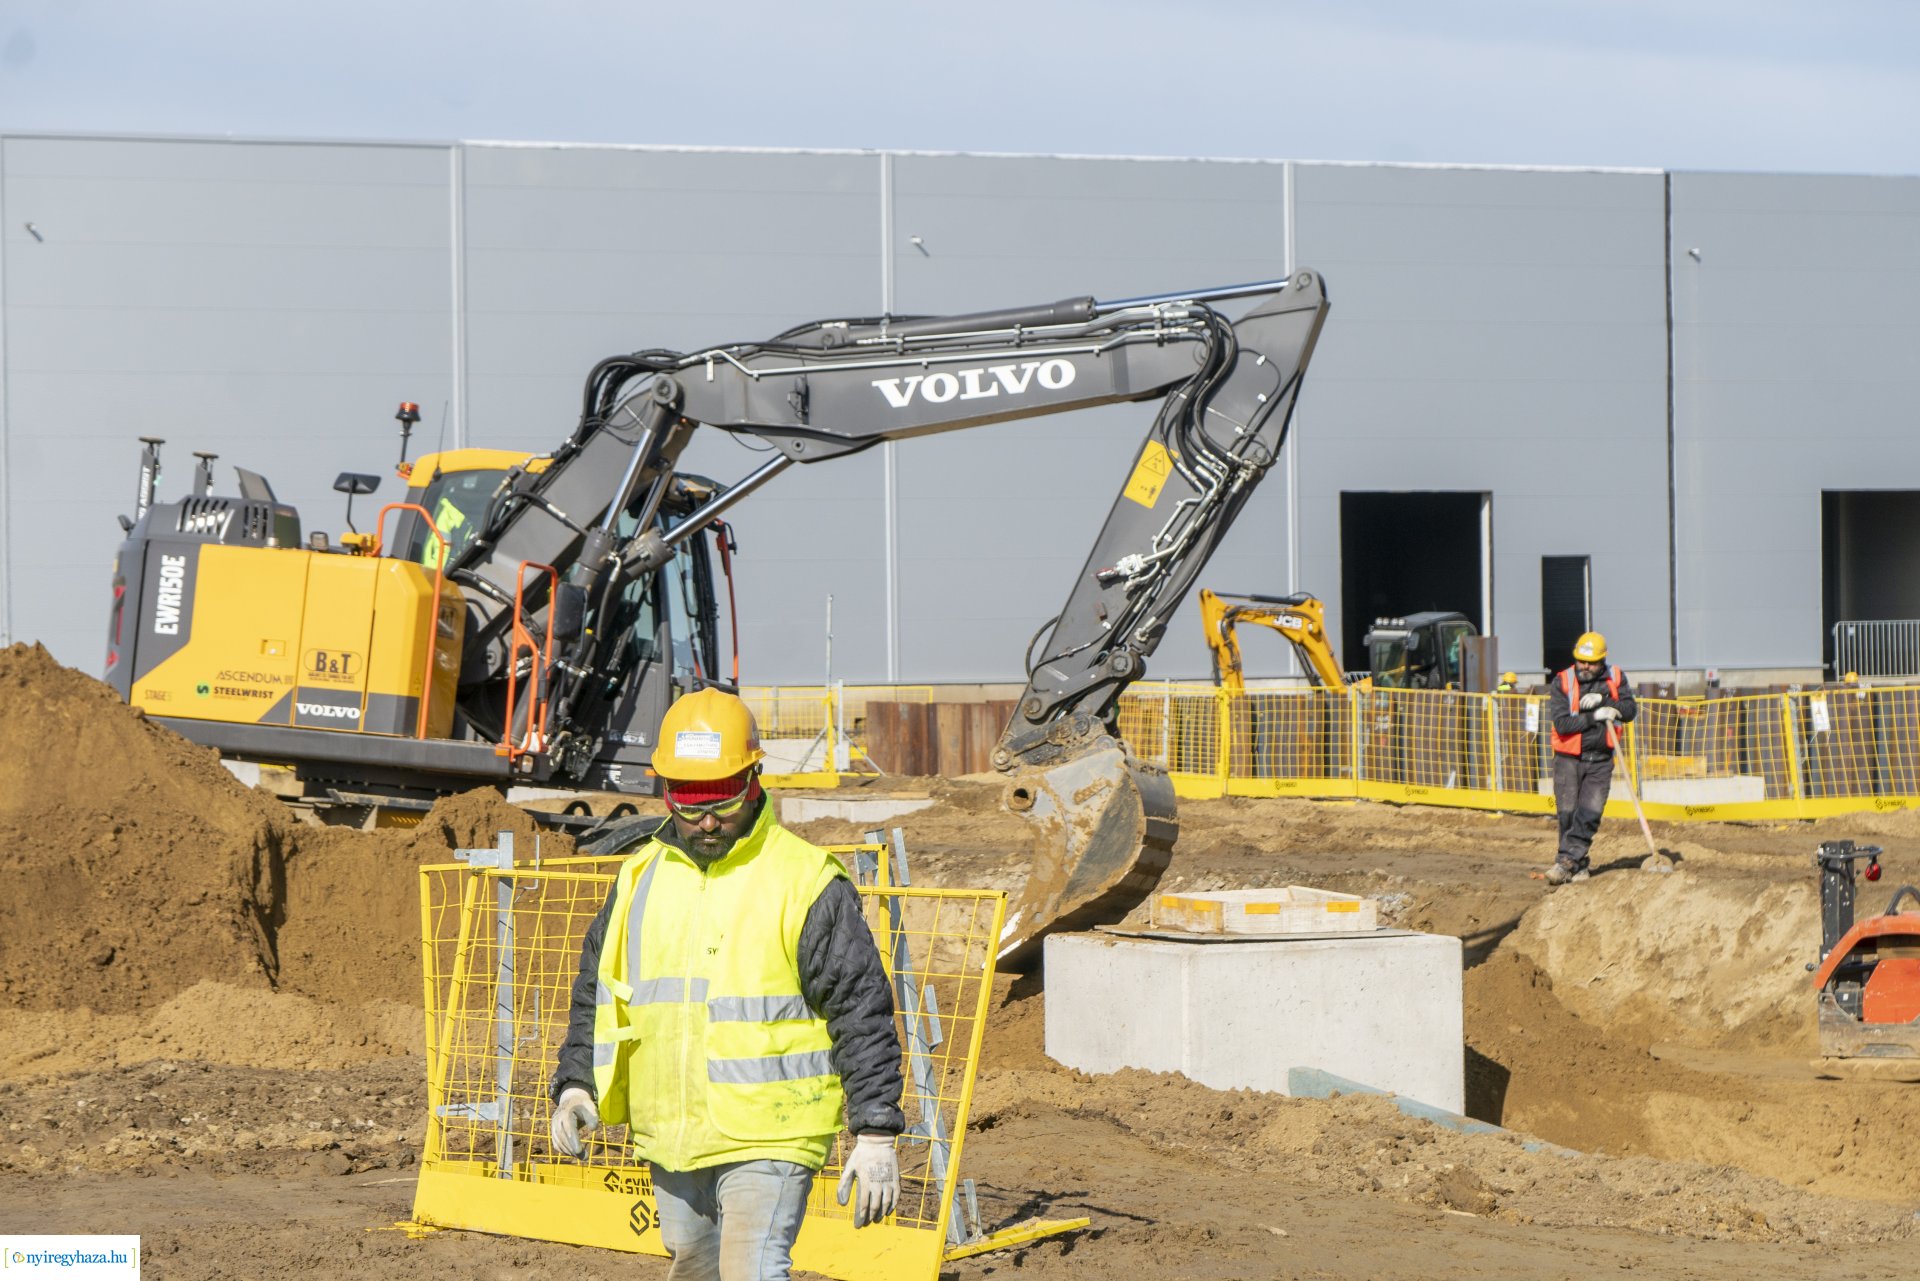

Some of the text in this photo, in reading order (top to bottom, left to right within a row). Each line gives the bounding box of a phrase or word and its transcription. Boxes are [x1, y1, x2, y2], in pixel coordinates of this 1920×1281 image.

[872, 359, 1076, 408] VOLVO
[154, 555, 186, 635] EWR150E
[1273, 614, 1302, 629] JCB
[216, 670, 282, 684] ASCENDUM
[214, 686, 273, 699] STEELWRIST
[295, 703, 361, 719] VOLVO
[625, 1178, 654, 1196] SYN
